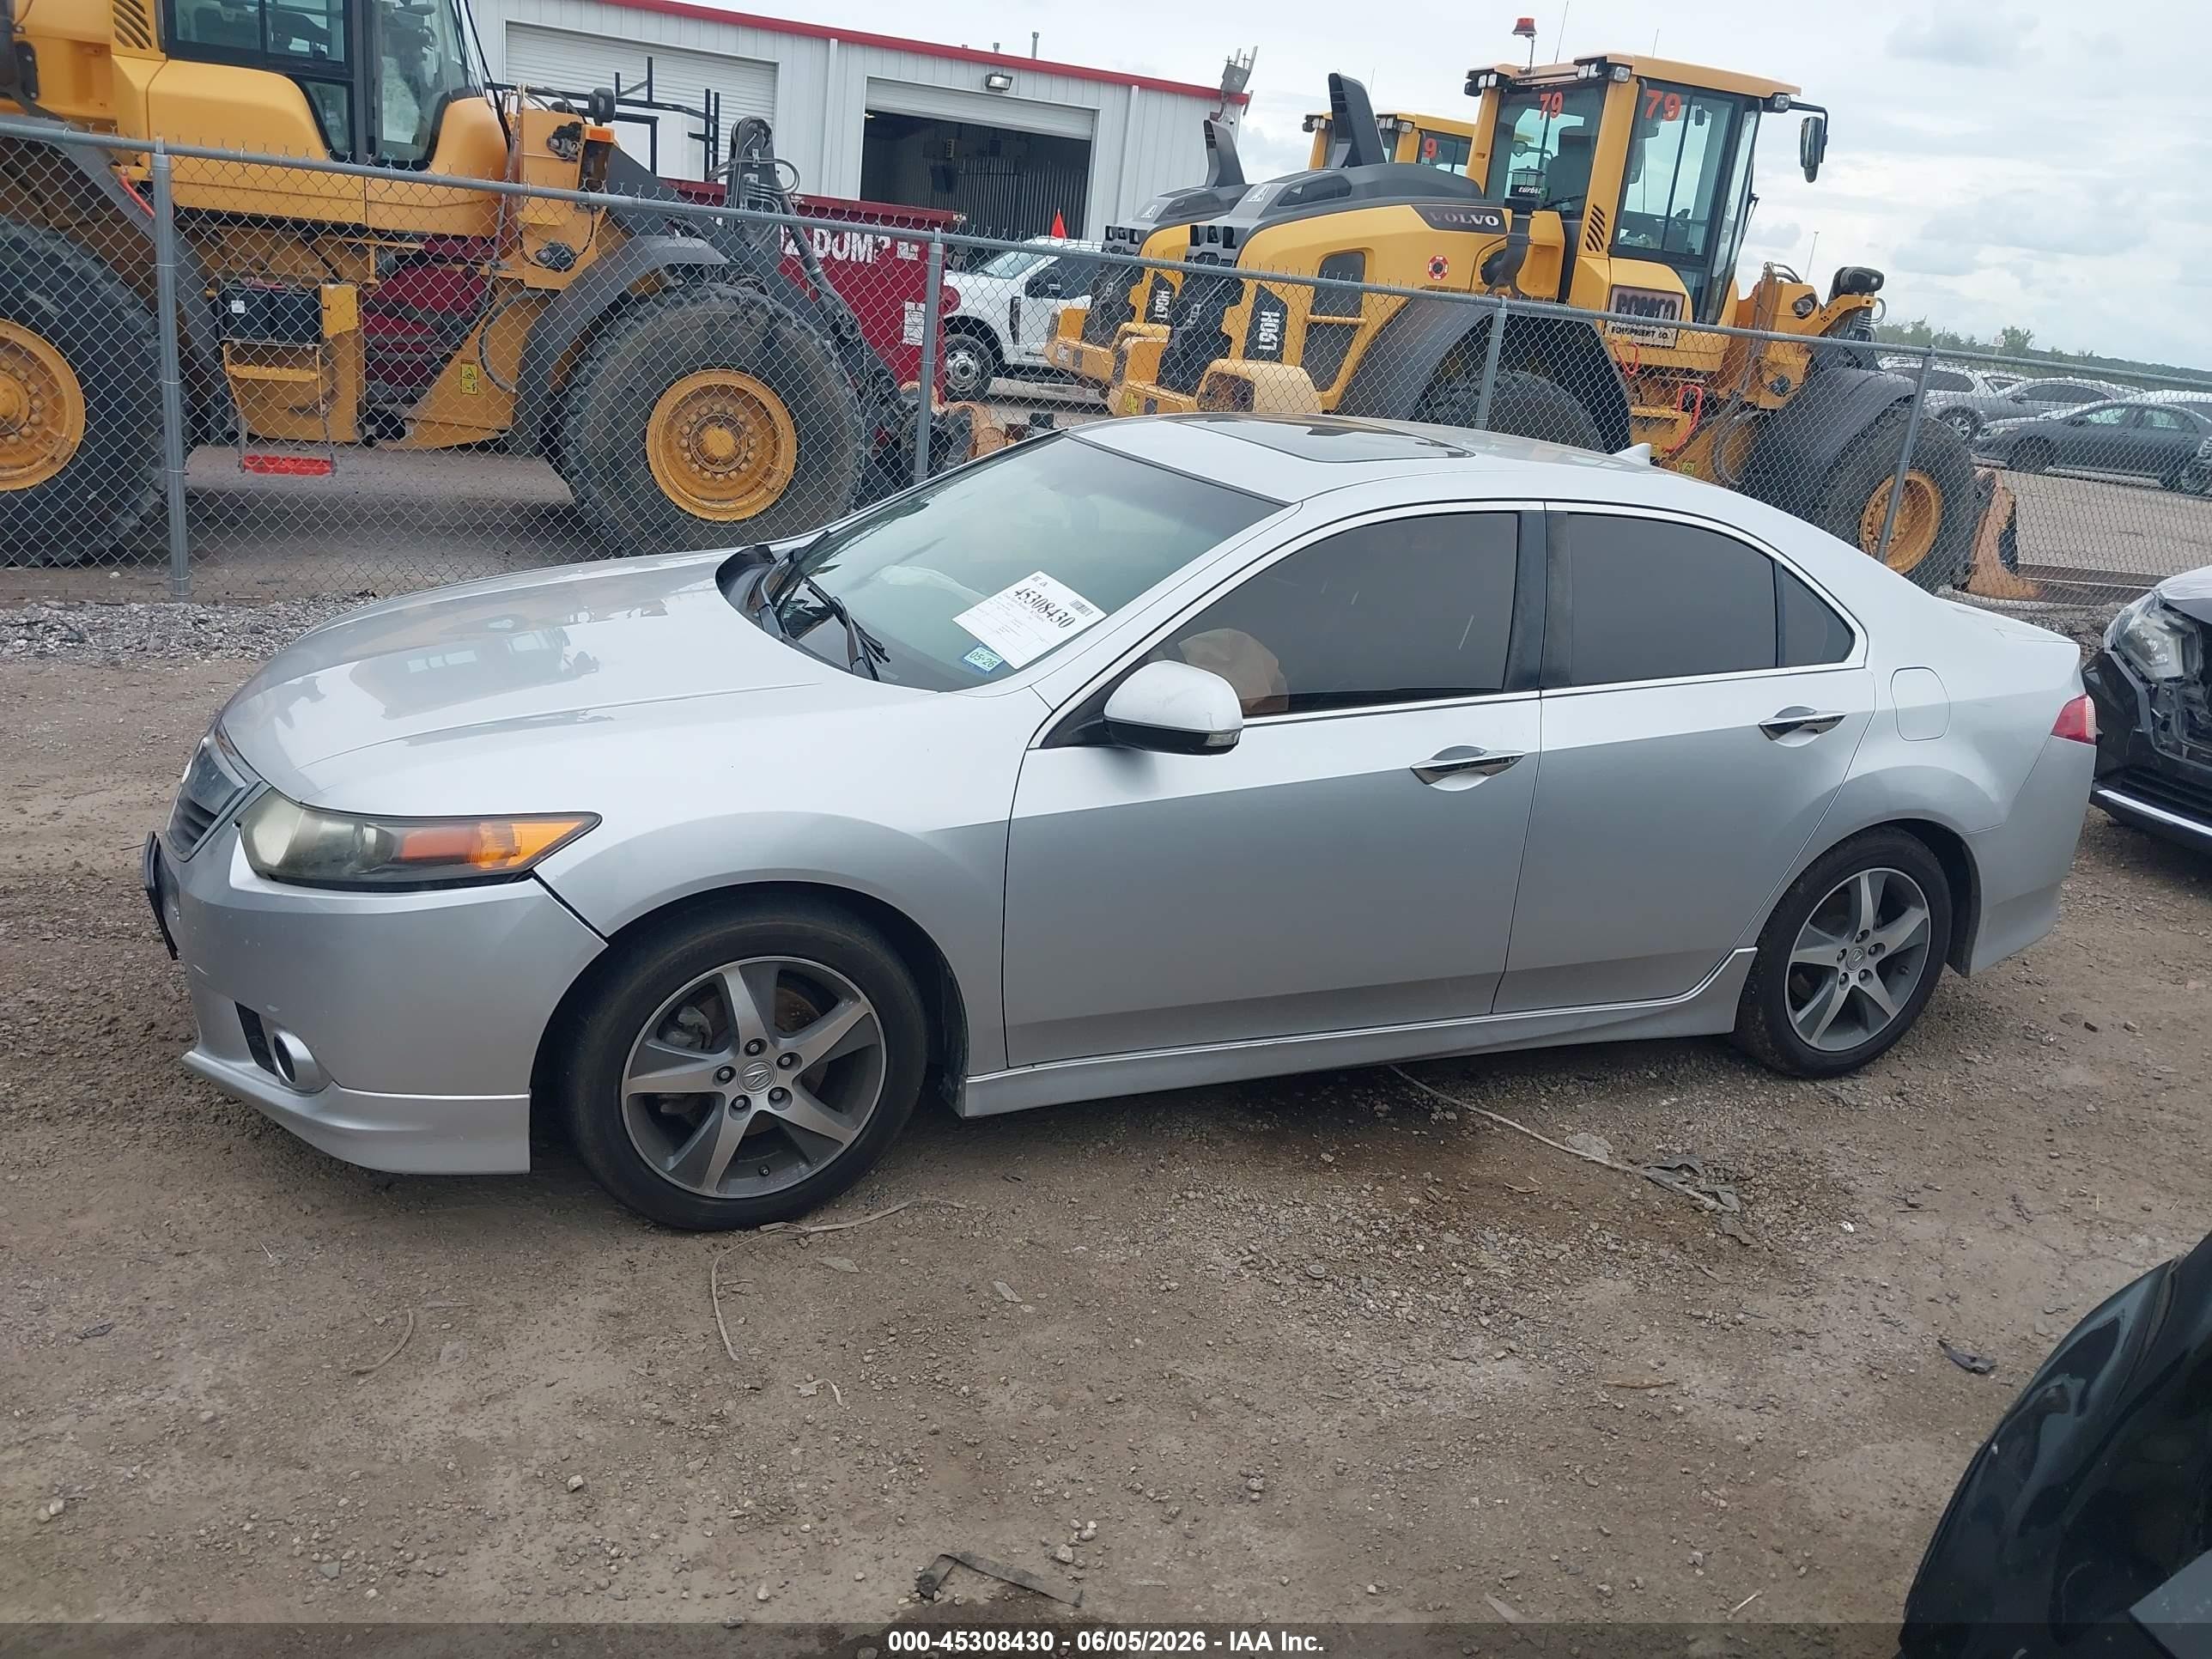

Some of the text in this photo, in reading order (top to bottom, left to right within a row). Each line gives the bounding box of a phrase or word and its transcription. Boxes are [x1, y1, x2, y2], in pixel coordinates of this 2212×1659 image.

[1539, 92, 1563, 120] 79
[1644, 88, 1682, 121] 79
[1429, 211, 1499, 228] VOLVO
[1257, 311, 1281, 351] L90H
[1014, 587, 1076, 629] 45308430
